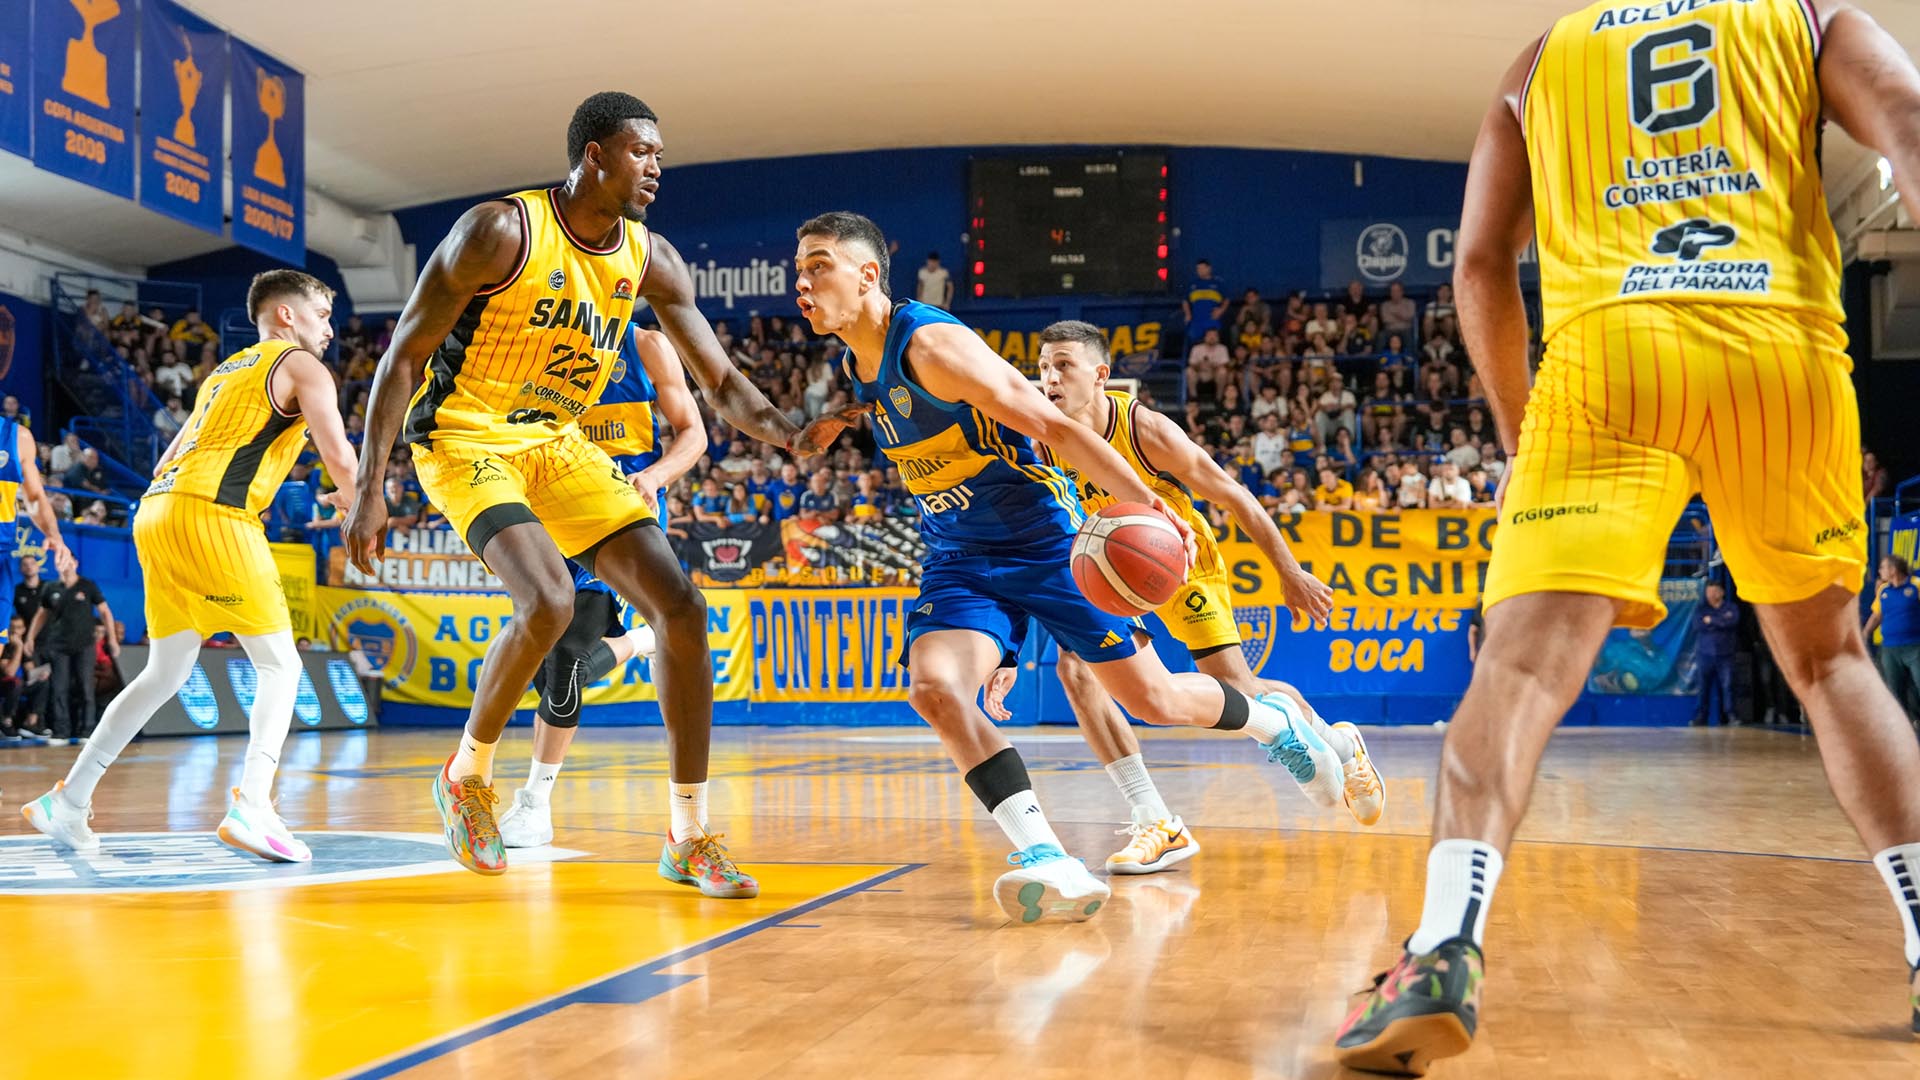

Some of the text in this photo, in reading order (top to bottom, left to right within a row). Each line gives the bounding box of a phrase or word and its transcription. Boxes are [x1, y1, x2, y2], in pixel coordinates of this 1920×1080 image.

[1593, 0, 1748, 31] ACEV
[1631, 24, 1717, 133] 6
[1626, 147, 1731, 180] LOTERÍA
[1605, 172, 1762, 208] CORRENTINA
[690, 258, 786, 309] hiquita
[1621, 280, 1664, 294] DEL
[1628, 262, 1769, 279] PREVISORA
[529, 298, 594, 336] SAN
[545, 343, 600, 392] 22
[875, 415, 900, 445] 11
[470, 473, 499, 488] NEXO
[1332, 512, 1400, 548] DE
[750, 599, 911, 690] PONTEVE
[1329, 638, 1425, 673] BOCA
